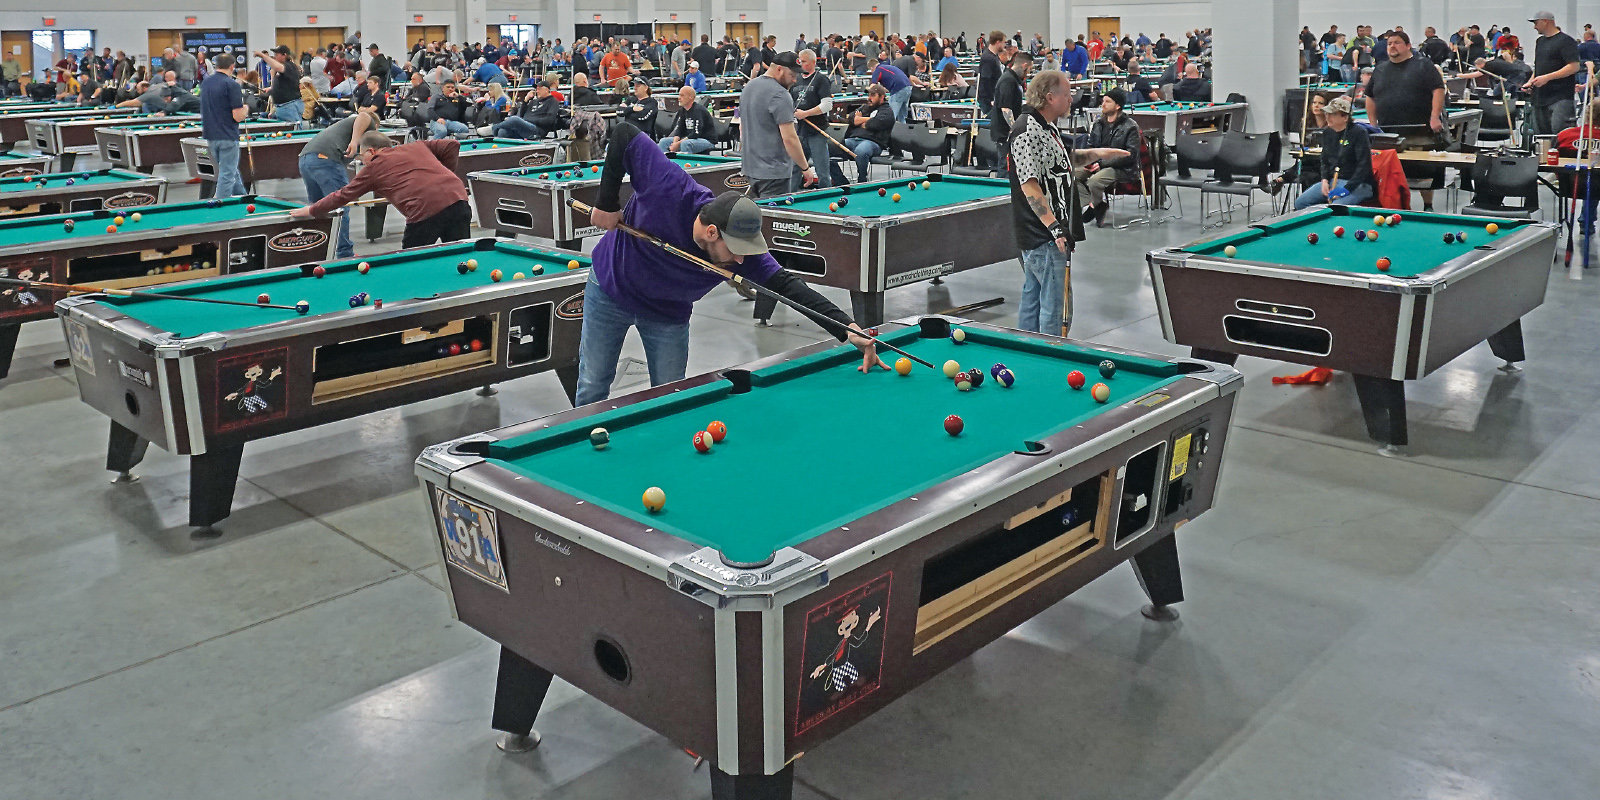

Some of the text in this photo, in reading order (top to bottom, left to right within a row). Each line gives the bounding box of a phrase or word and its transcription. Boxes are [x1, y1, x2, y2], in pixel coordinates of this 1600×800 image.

[772, 221, 811, 233] mueller
[277, 233, 319, 245] MERCURY
[455, 518, 486, 567] 91
